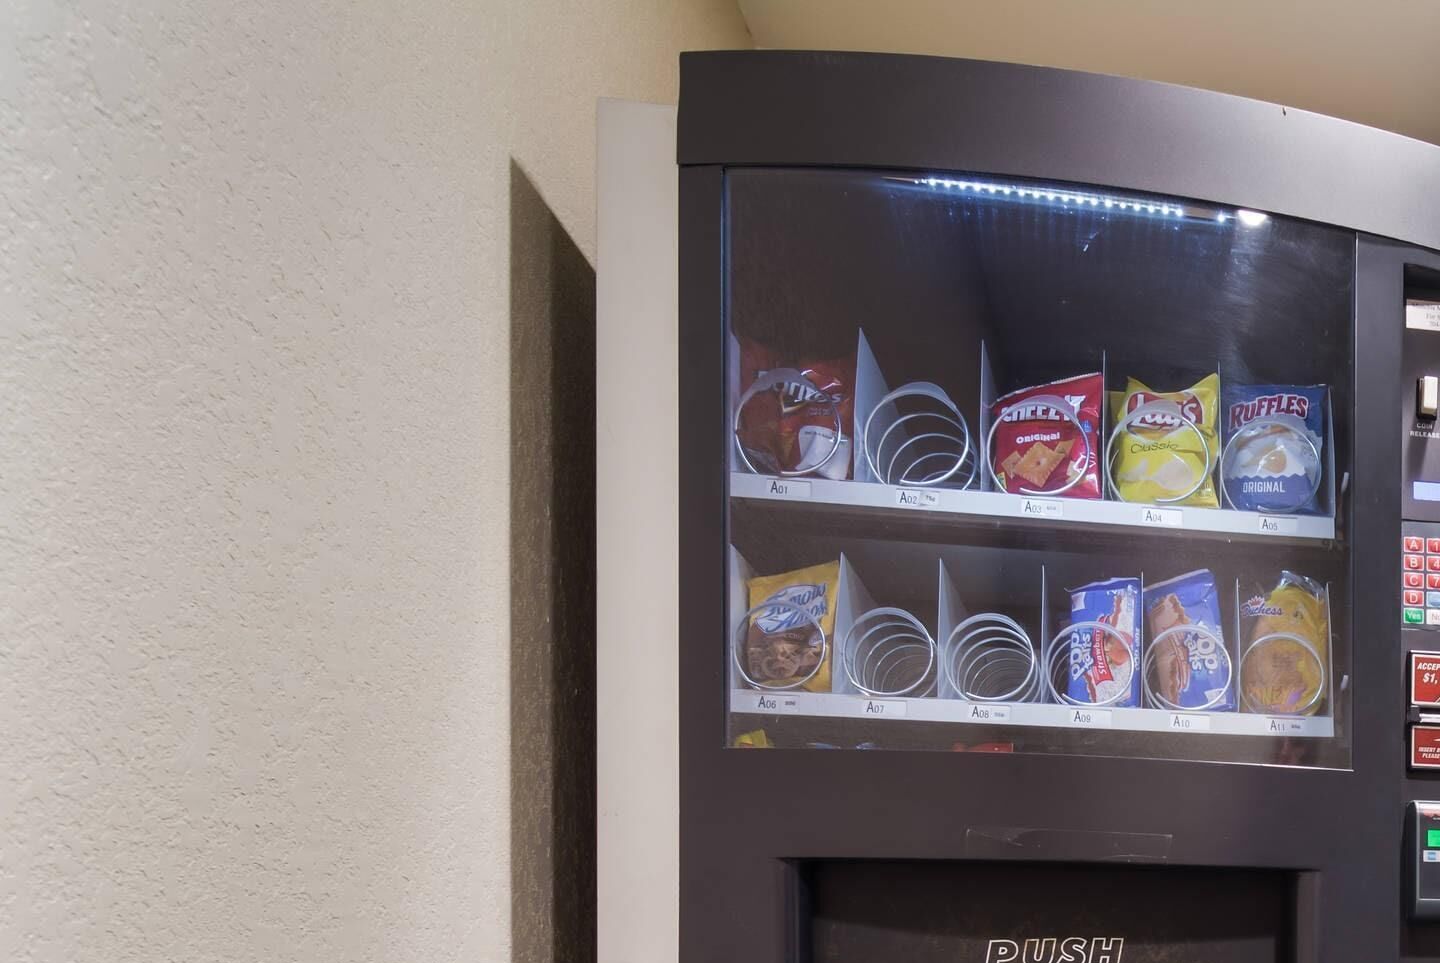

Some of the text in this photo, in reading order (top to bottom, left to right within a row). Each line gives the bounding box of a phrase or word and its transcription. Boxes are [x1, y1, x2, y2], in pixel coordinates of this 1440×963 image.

[1230, 394, 1308, 431] RUFFLES
[1410, 430, 1440, 438] RELEASE
[770, 481, 788, 495] A01
[1243, 482, 1286, 493] ORIGINAL
[900, 491, 917, 504] A02
[1024, 501, 1042, 513] A03
[1145, 510, 1162, 523] A04
[1261, 520, 1278, 531] A05
[1410, 540, 1418, 550] A
[1434, 541, 1439, 551] 1
[1410, 559, 1418, 568] B
[1433, 559, 1440, 569] 4
[1410, 575, 1418, 585] C
[1433, 577, 1440, 587] 7
[1410, 593, 1418, 603] D
[1423, 673, 1438, 684] $1,
[758, 695, 777, 709] A06
[866, 701, 884, 713] A07
[972, 706, 989, 719] A08
[1074, 711, 1091, 723] A09
[1173, 715, 1190, 728] A10
[1270, 720, 1285, 731] A11
